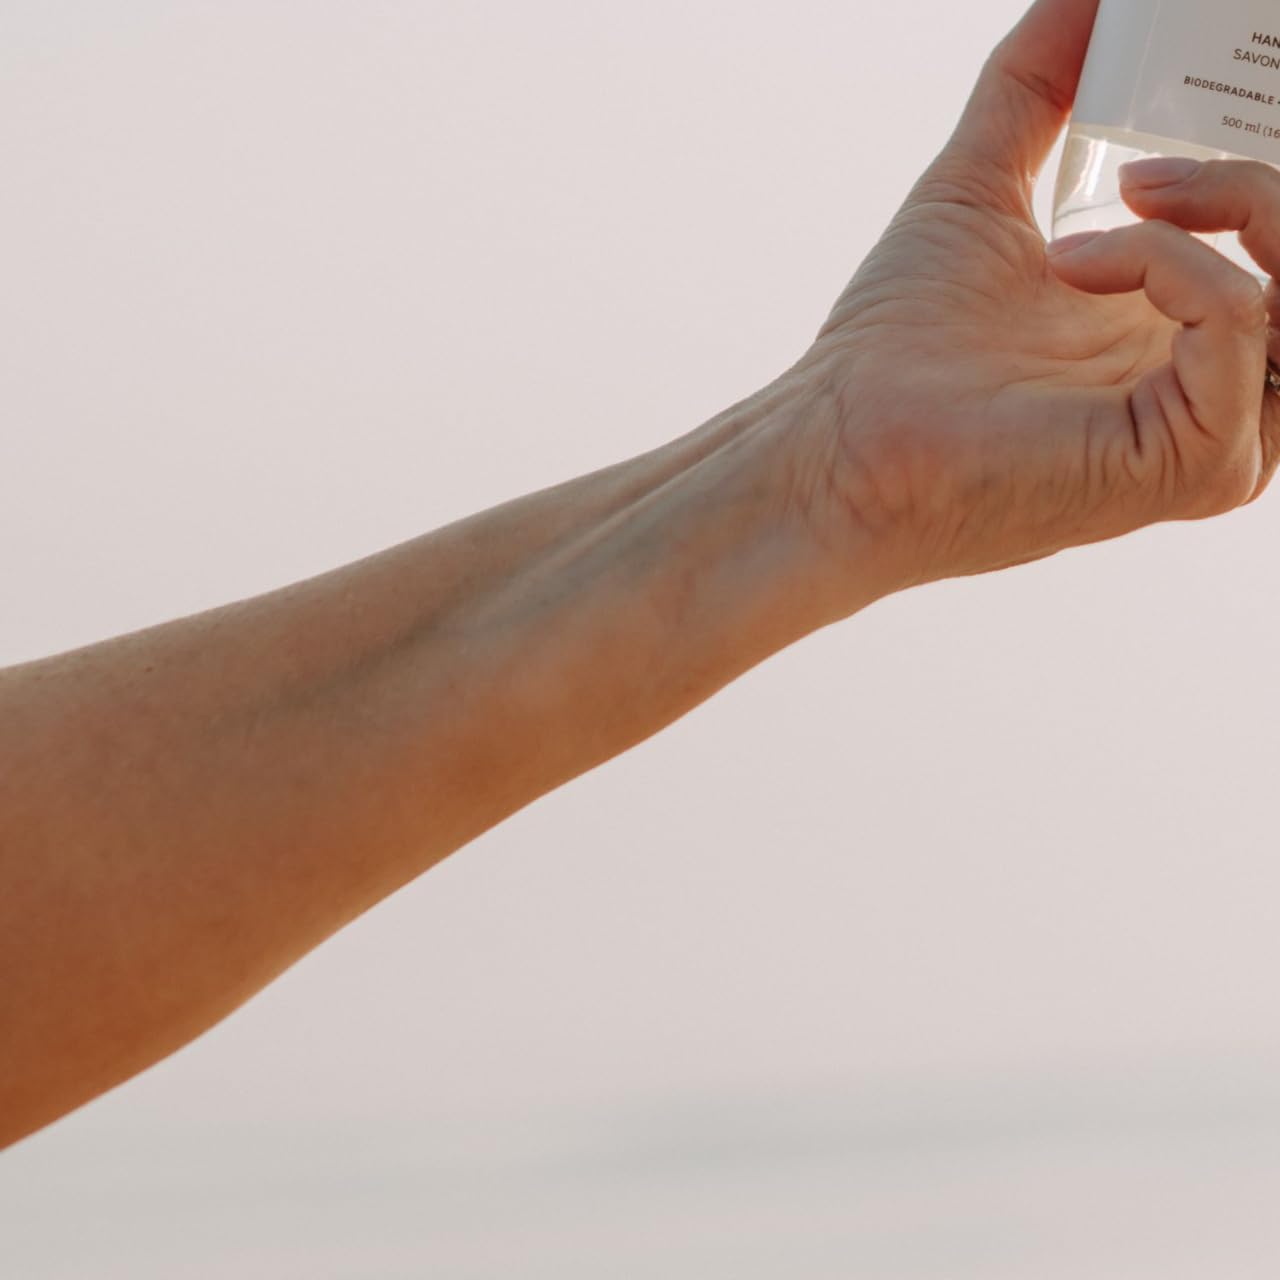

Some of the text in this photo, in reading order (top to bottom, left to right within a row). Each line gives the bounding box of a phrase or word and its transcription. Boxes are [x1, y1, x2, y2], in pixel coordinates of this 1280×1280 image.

[1233, 48, 1280, 70] SAVON
[1183, 75, 1275, 105] BIODEGRADABLE
[1221, 115, 1243, 129] 500
[1244, 121, 1261, 134] ml
